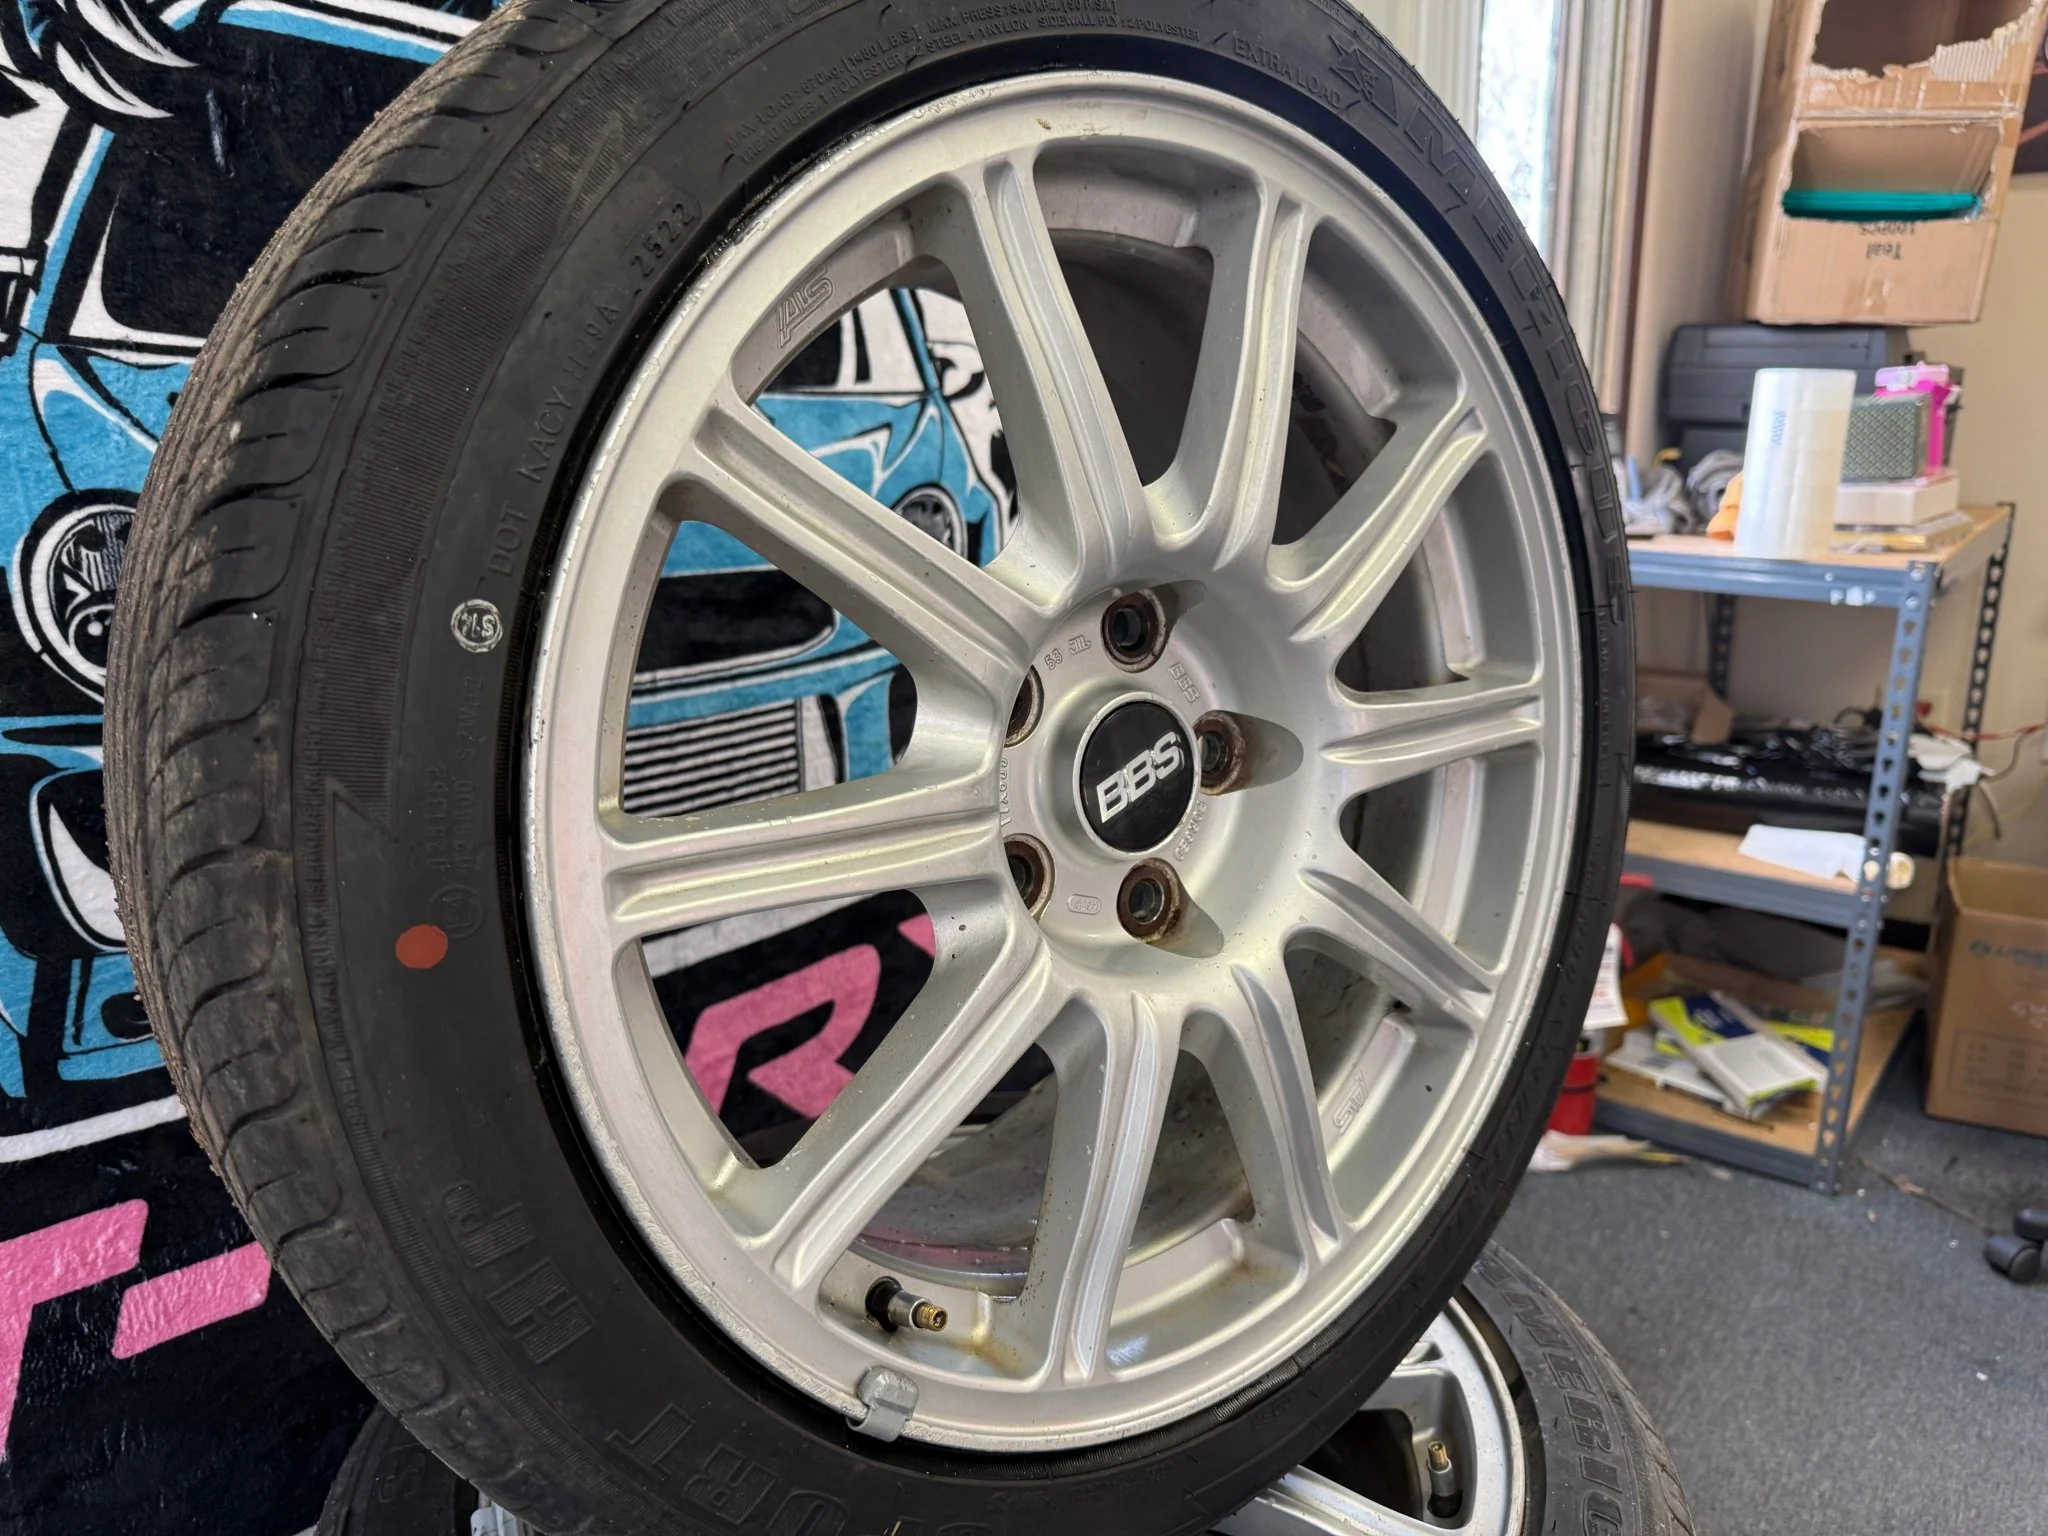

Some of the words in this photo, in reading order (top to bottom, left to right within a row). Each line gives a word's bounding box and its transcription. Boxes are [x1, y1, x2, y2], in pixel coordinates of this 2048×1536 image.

[1232, 36, 1294, 81] EXTRA
[1295, 66, 1342, 110] LOAD
[486, 501, 530, 578] DOT
[628, 201, 700, 280] 2522
[1044, 647, 1063, 671] 53
[1168, 661, 1200, 703] BBS
[1095, 730, 1186, 825] BBS
[1174, 799, 1207, 863] FORGED
[441, 1180, 597, 1365] HP
